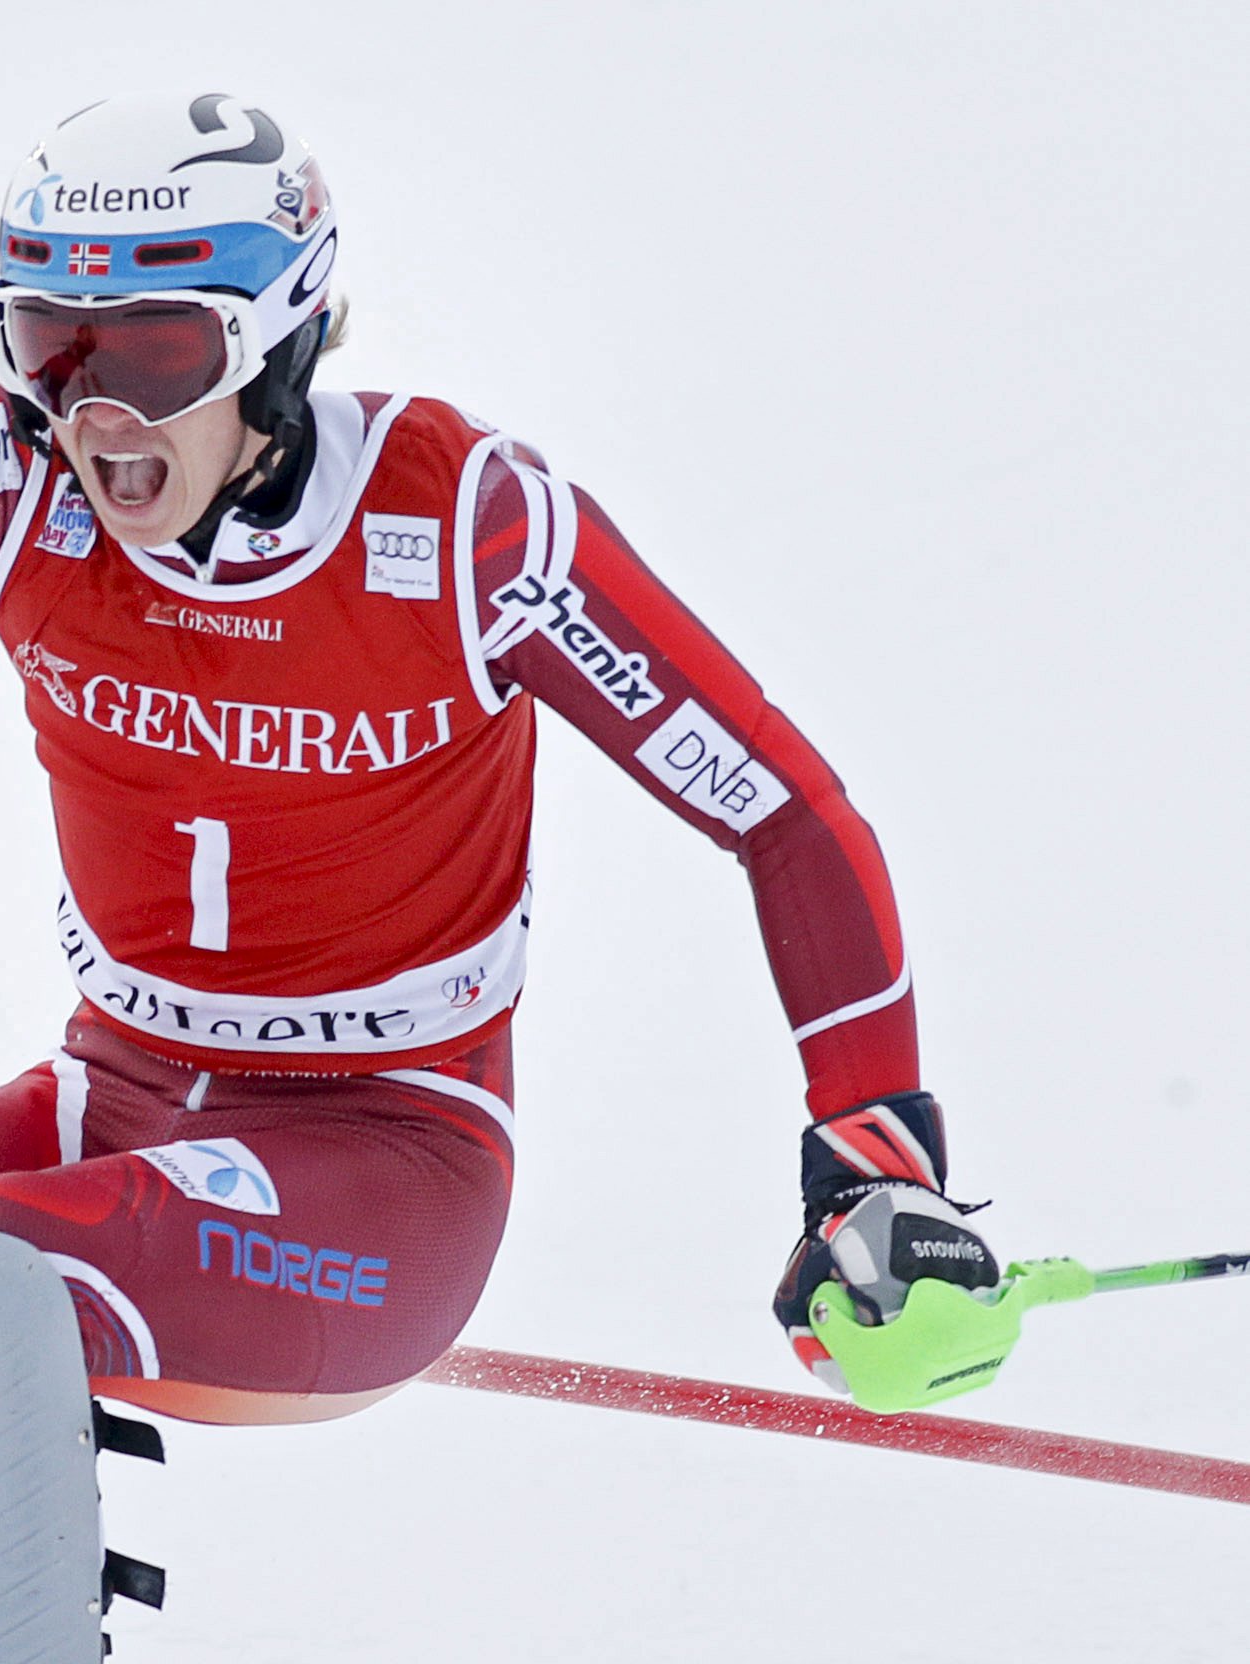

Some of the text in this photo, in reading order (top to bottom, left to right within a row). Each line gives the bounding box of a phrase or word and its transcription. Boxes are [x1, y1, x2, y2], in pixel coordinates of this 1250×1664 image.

[55, 183, 190, 213] telenor
[178, 606, 283, 642] GENERALI
[498, 575, 654, 712] phenix
[82, 673, 455, 775] GENERALI
[664, 730, 758, 815] DNB
[174, 816, 231, 952] 1
[197, 1219, 389, 1308] NORGE
[910, 1235, 986, 1263] snowlife
